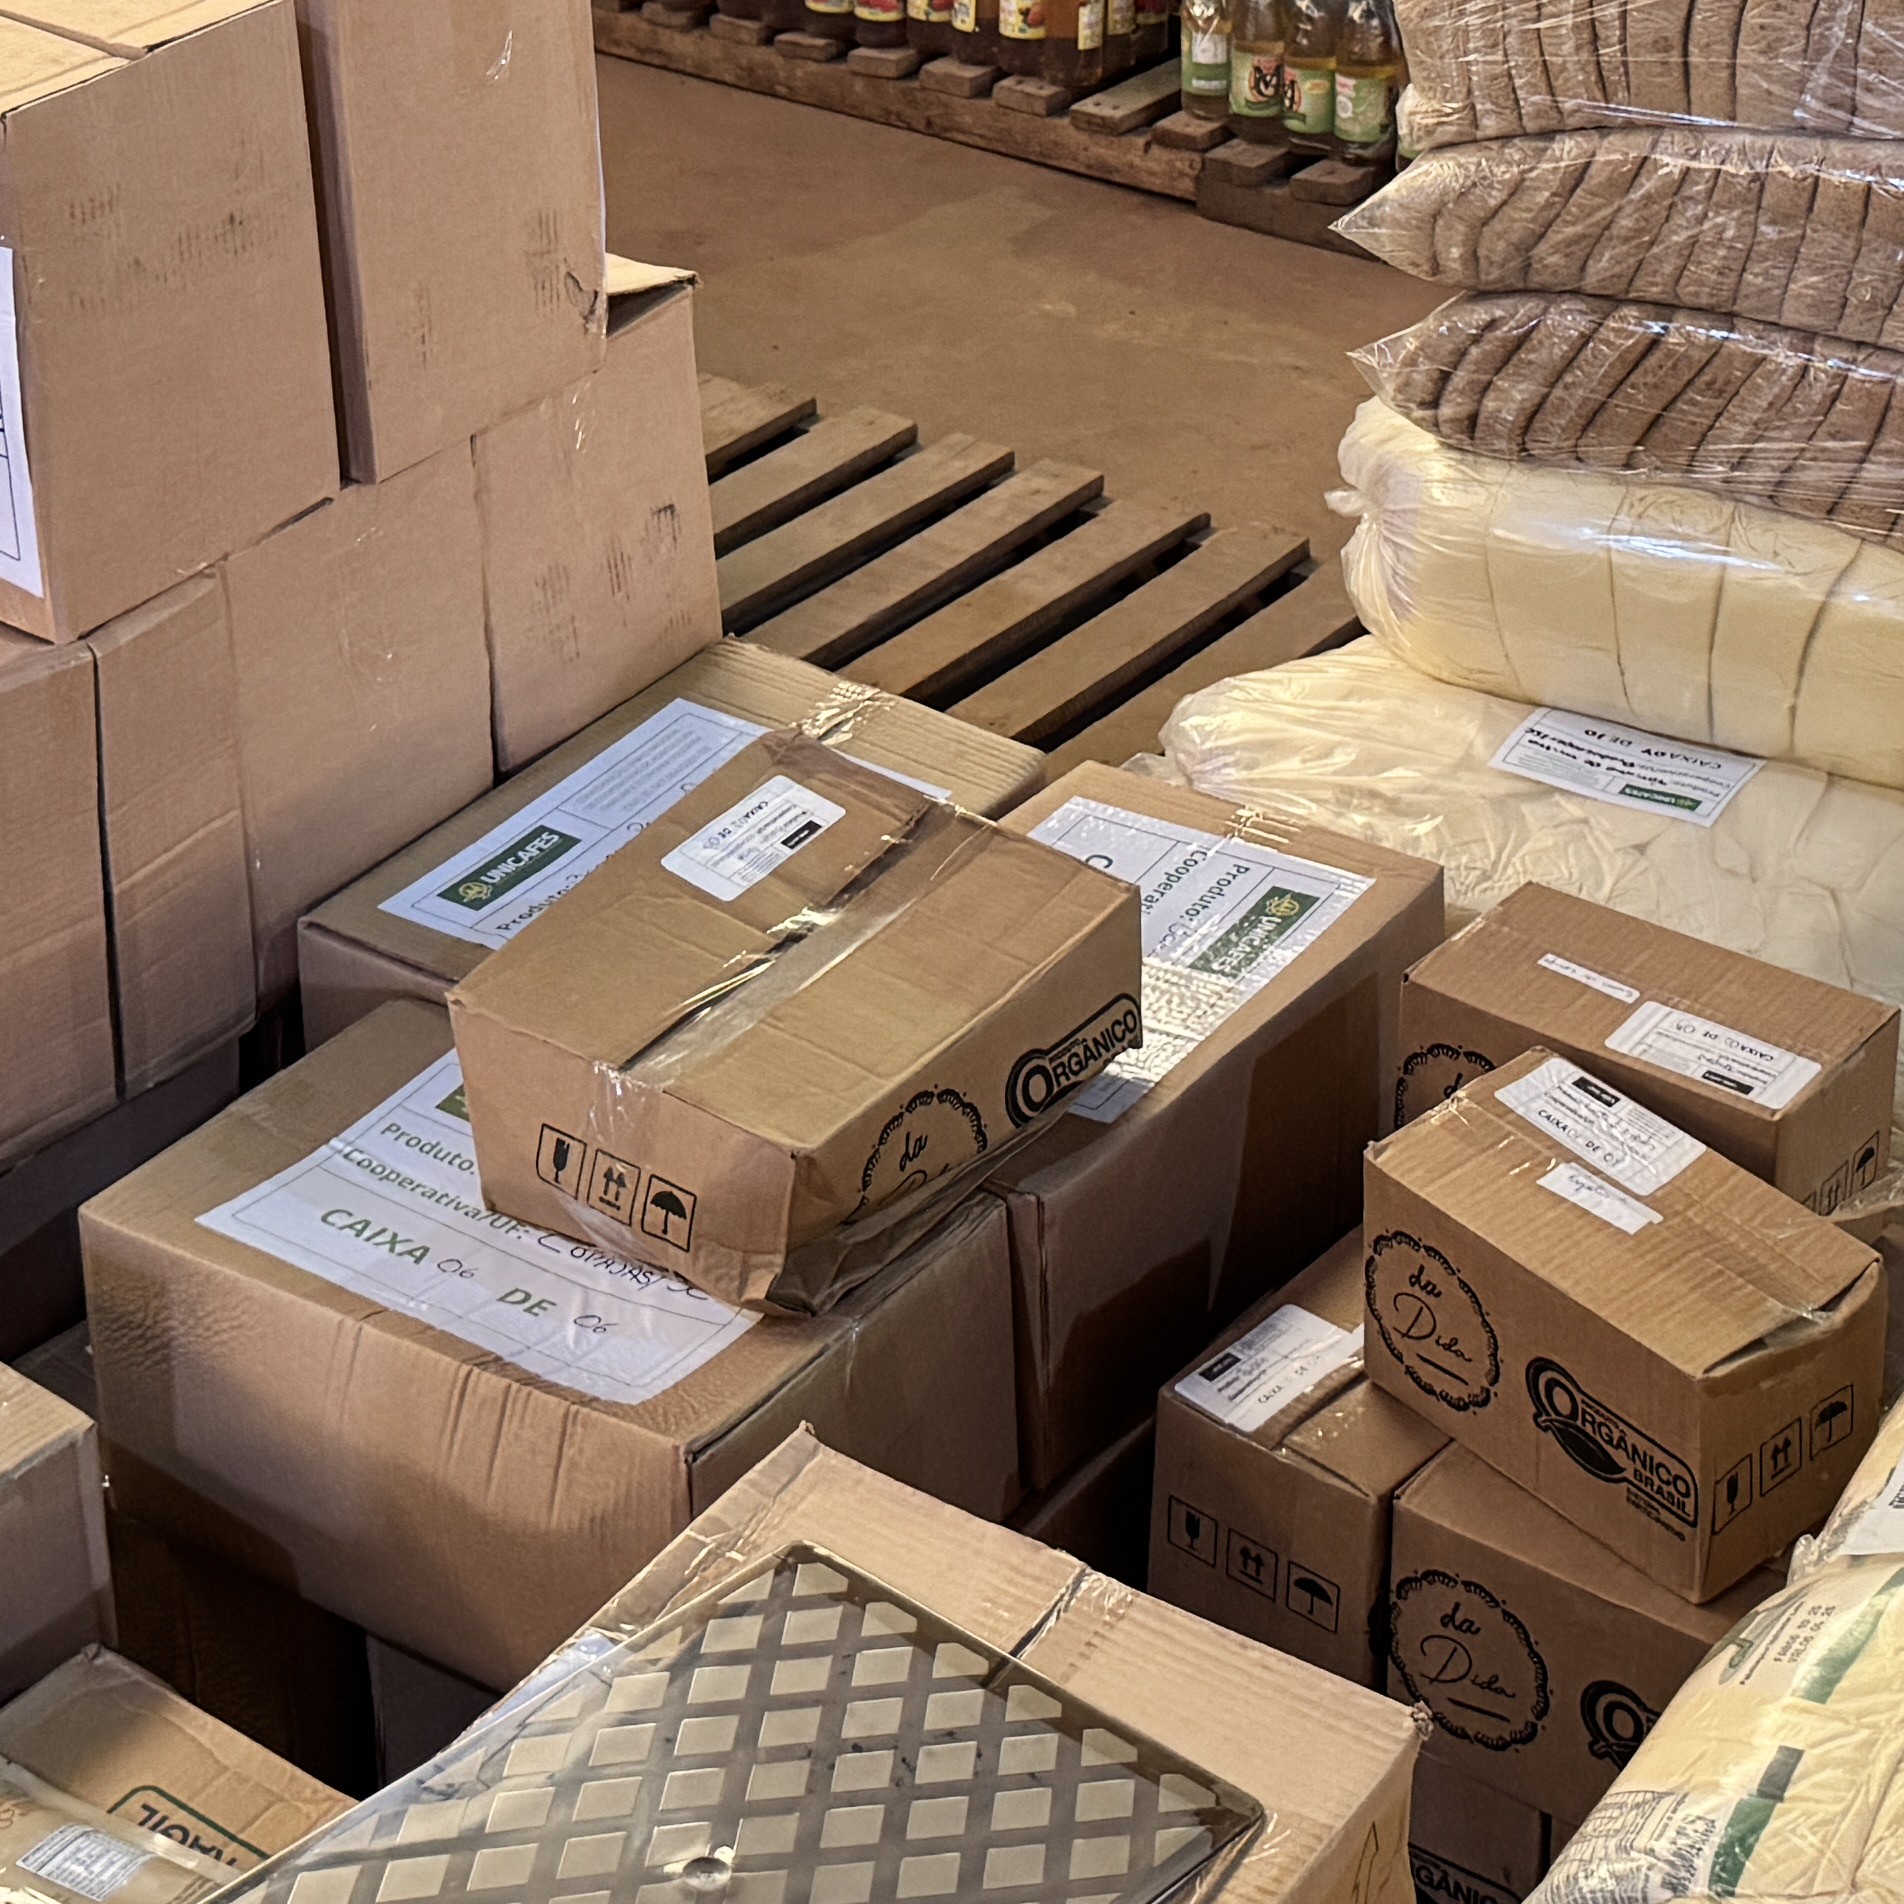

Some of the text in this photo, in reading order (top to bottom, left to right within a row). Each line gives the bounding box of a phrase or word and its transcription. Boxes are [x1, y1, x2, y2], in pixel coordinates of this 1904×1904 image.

[481, 829, 561, 886] UNICAFES
[1021, 1007, 1139, 1116] ORGÂNICO
[1538, 1108, 1568, 1133] CAIXA
[318, 1206, 433, 1268] CAIXA
[495, 1284, 558, 1319] DE
[1548, 1379, 1693, 1498] ORGÂNICO
[1629, 1464, 1691, 1516] BRASIL
